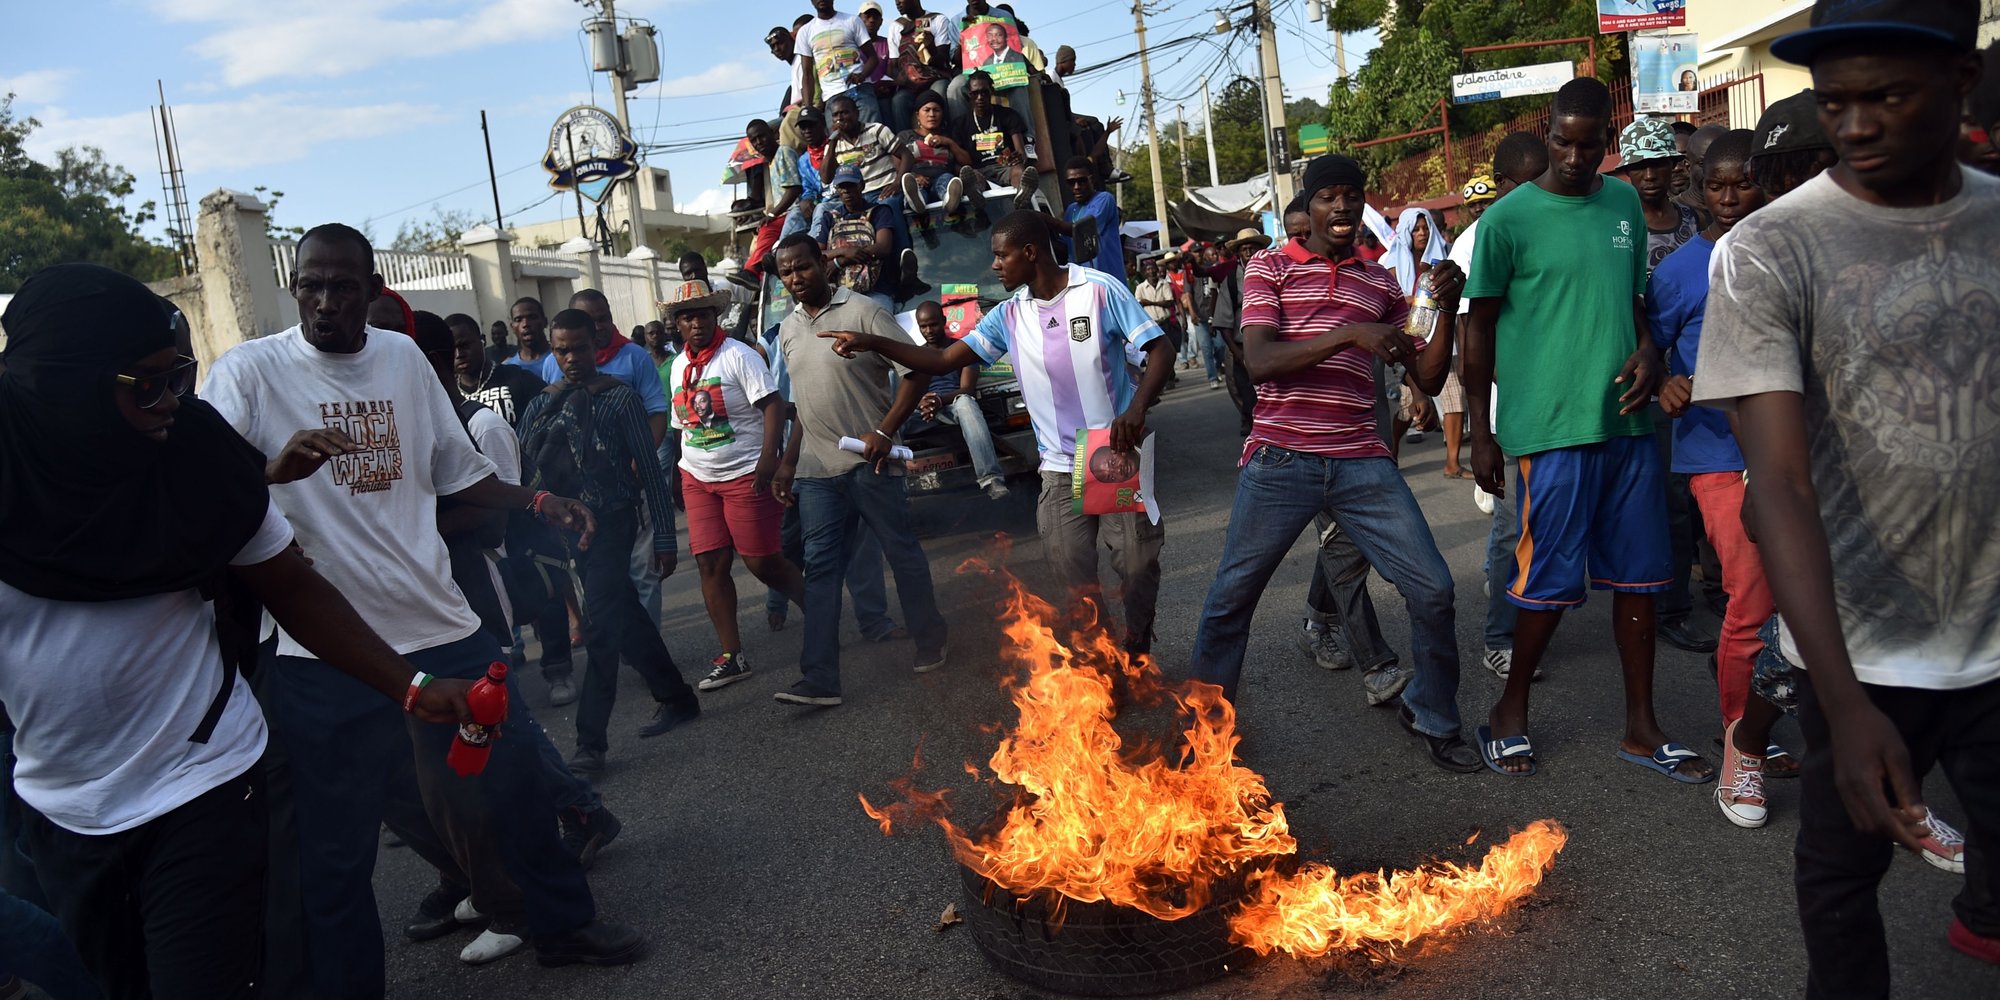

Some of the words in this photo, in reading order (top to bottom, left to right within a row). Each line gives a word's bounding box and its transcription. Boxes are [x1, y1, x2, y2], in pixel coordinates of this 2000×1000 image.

[575, 162, 609, 177] ONATEL
[320, 400, 394, 415] TEAMROC
[329, 448, 402, 486] WEAR
[1075, 444, 1084, 478] PREZIDAN
[1073, 479, 1082, 499] VOTE
